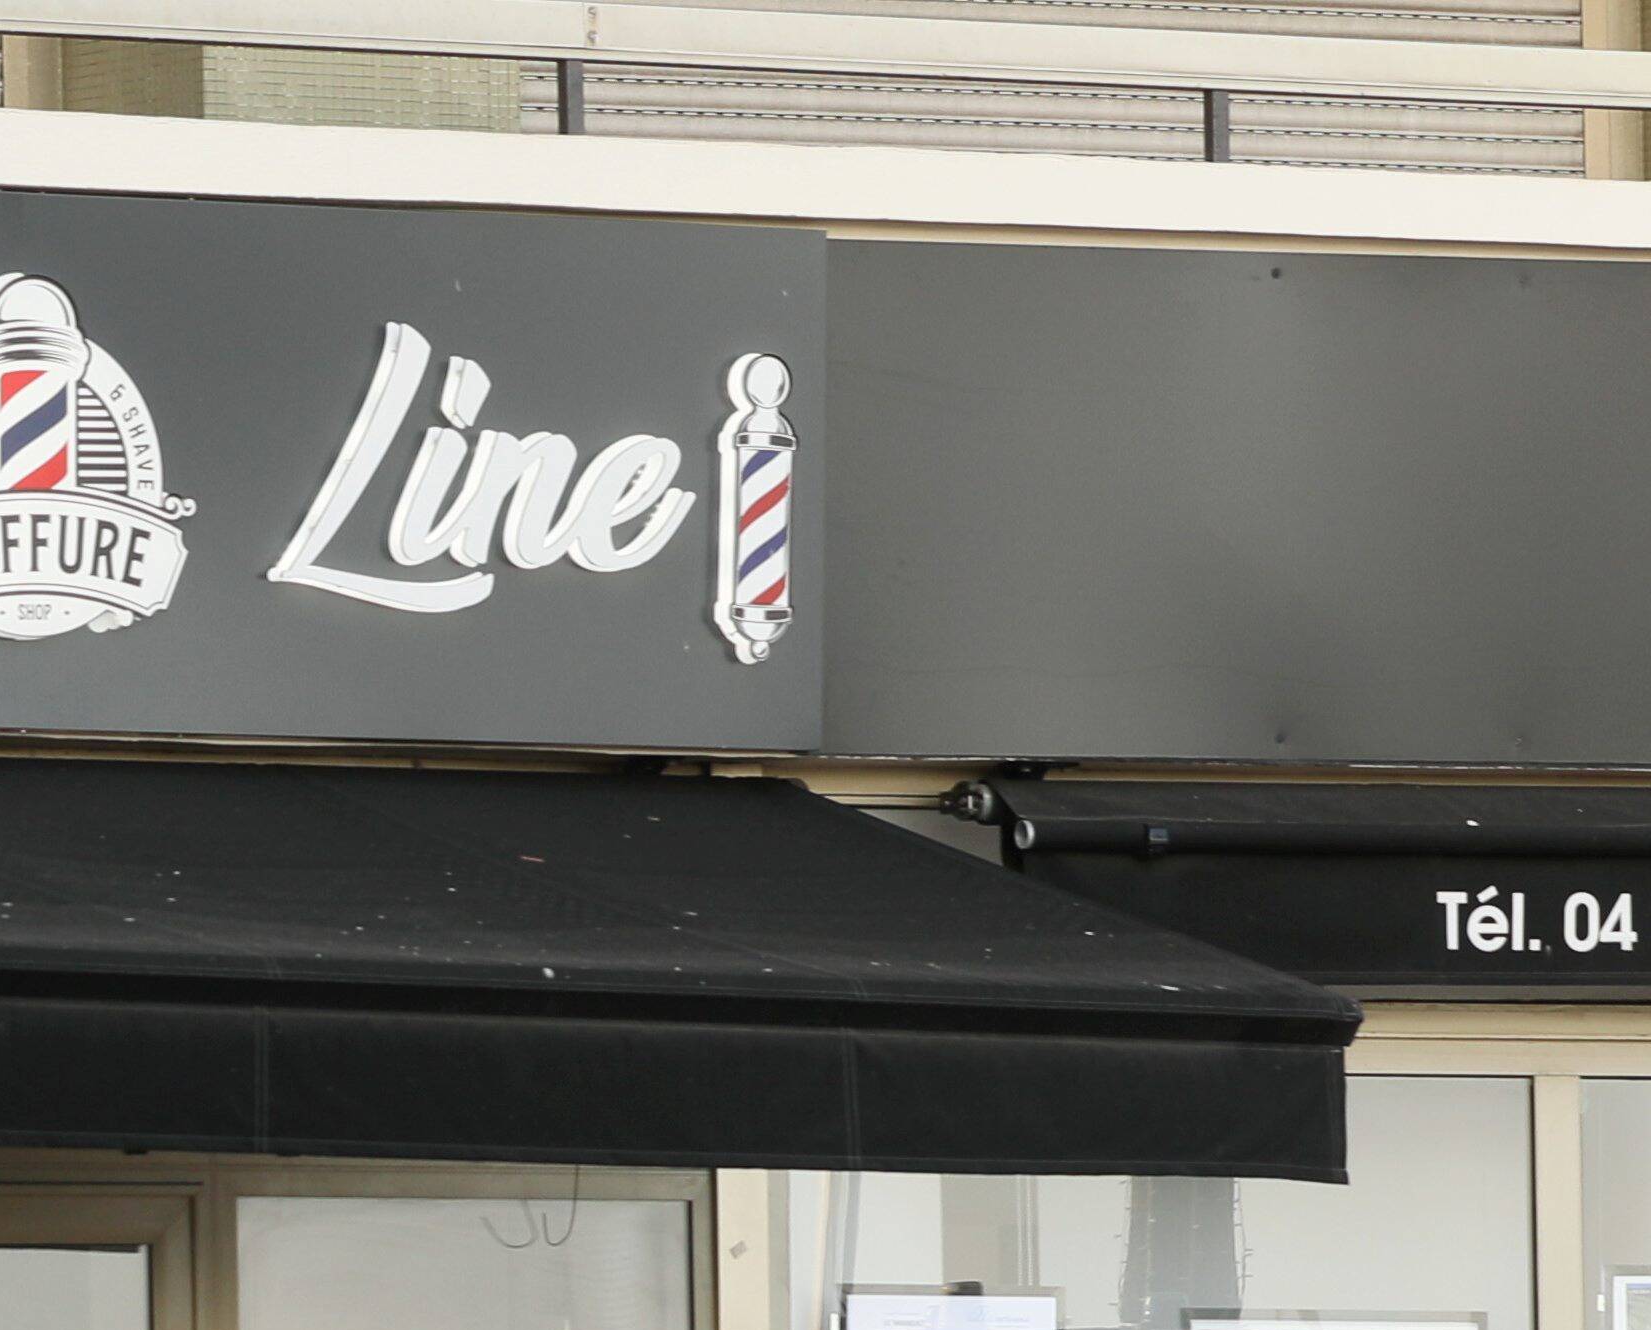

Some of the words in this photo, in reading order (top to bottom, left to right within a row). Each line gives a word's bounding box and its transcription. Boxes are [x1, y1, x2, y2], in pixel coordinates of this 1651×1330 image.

[122, 406, 155, 491] SHAVE
[266, 321, 698, 614] Line
[16, 603, 53, 621] SHOP
[1436, 885, 1542, 953] Tél.
[1563, 891, 1639, 953] 04
